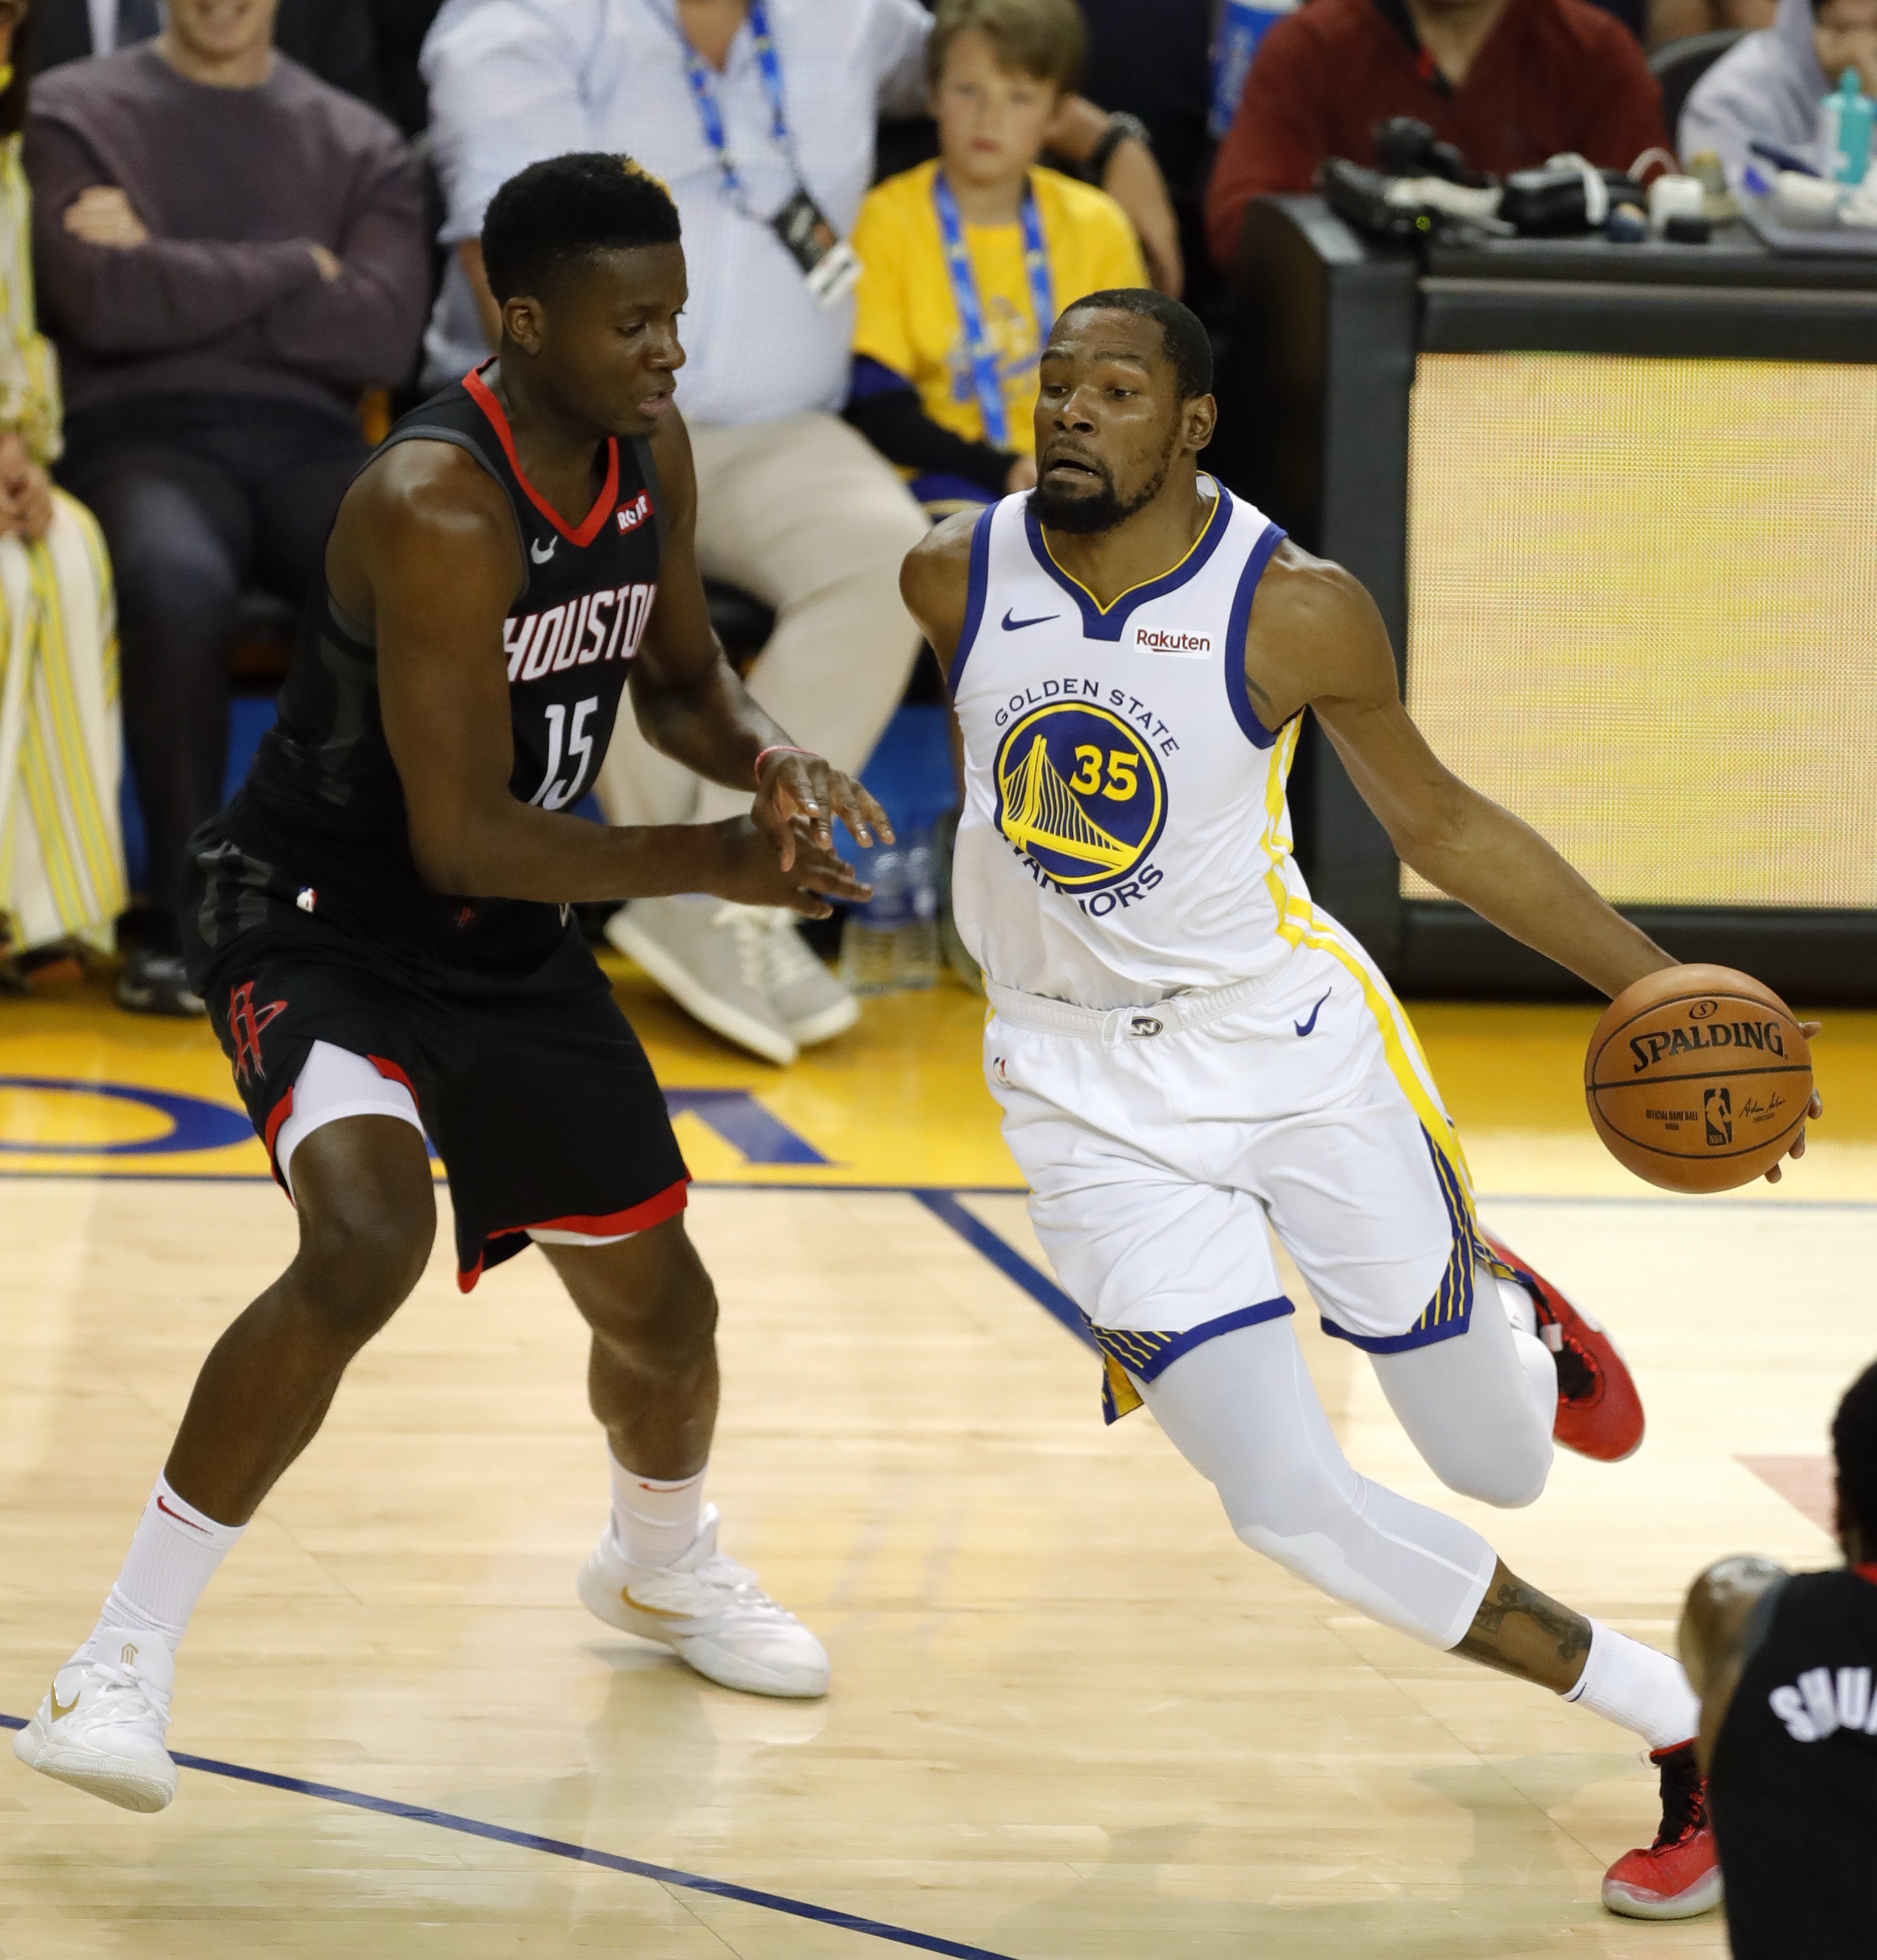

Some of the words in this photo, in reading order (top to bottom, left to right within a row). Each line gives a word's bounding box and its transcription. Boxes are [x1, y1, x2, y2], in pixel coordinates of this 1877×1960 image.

[503, 584, 657, 682] HOUSTO
[1137, 629, 1210, 651] Rakuten
[995, 678, 1099, 726] GOLDEN
[1108, 689, 1180, 756] STATE
[528, 695, 599, 810] 15
[1069, 744, 1139, 802] 35
[1629, 1021, 1784, 1073] SPALDING
[1685, 1110, 1698, 1121] BALL
